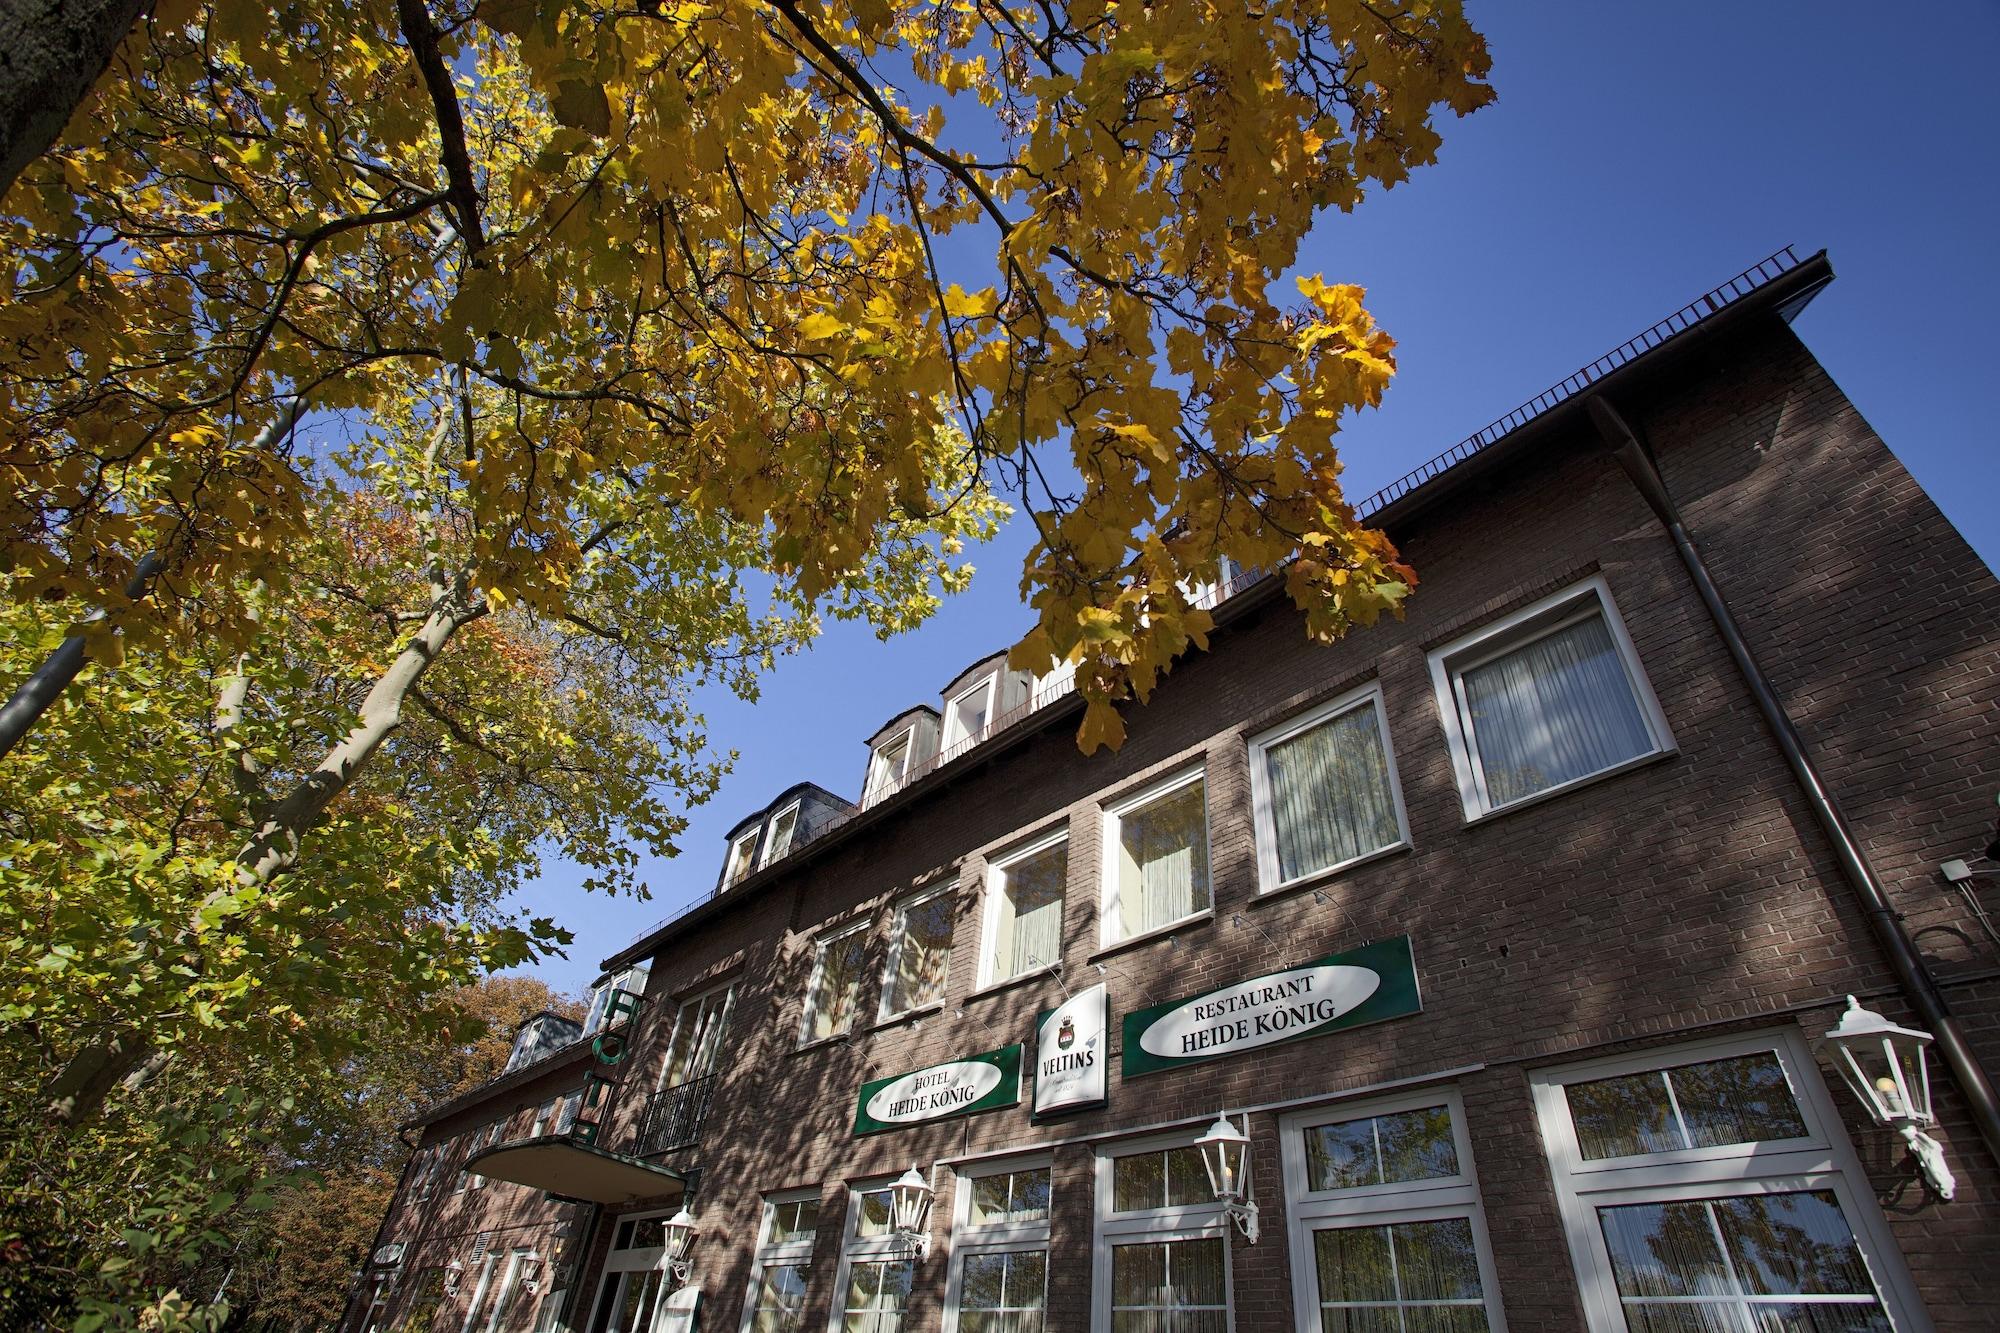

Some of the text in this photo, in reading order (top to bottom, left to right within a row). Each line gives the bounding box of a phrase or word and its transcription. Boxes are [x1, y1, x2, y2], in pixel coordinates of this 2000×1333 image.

[1194, 975, 1315, 1022] RESTAURANT
[1181, 998, 1336, 1054] HEIDE KÖNIG
[1043, 1050, 1095, 1077] VELTINS
[915, 1071, 950, 1091] HOTEL
[888, 1085, 975, 1118] HEIDE KÖNIG
